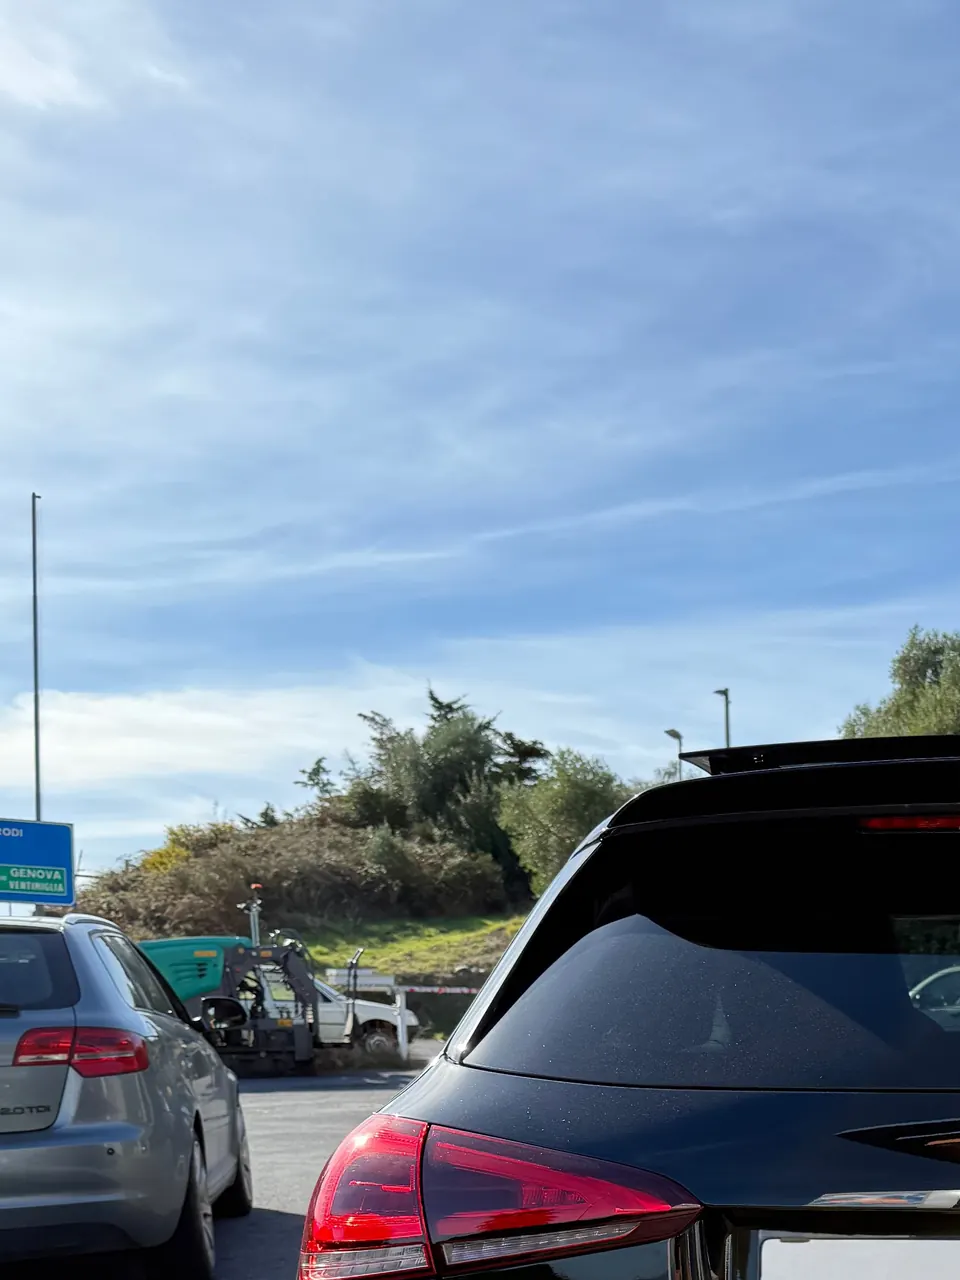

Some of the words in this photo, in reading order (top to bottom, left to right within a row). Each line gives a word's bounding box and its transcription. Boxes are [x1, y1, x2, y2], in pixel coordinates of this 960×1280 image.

[0, 827, 24, 837] ODI
[10, 868, 61, 880] GENOVA
[25, 1105, 51, 1114] TDI
